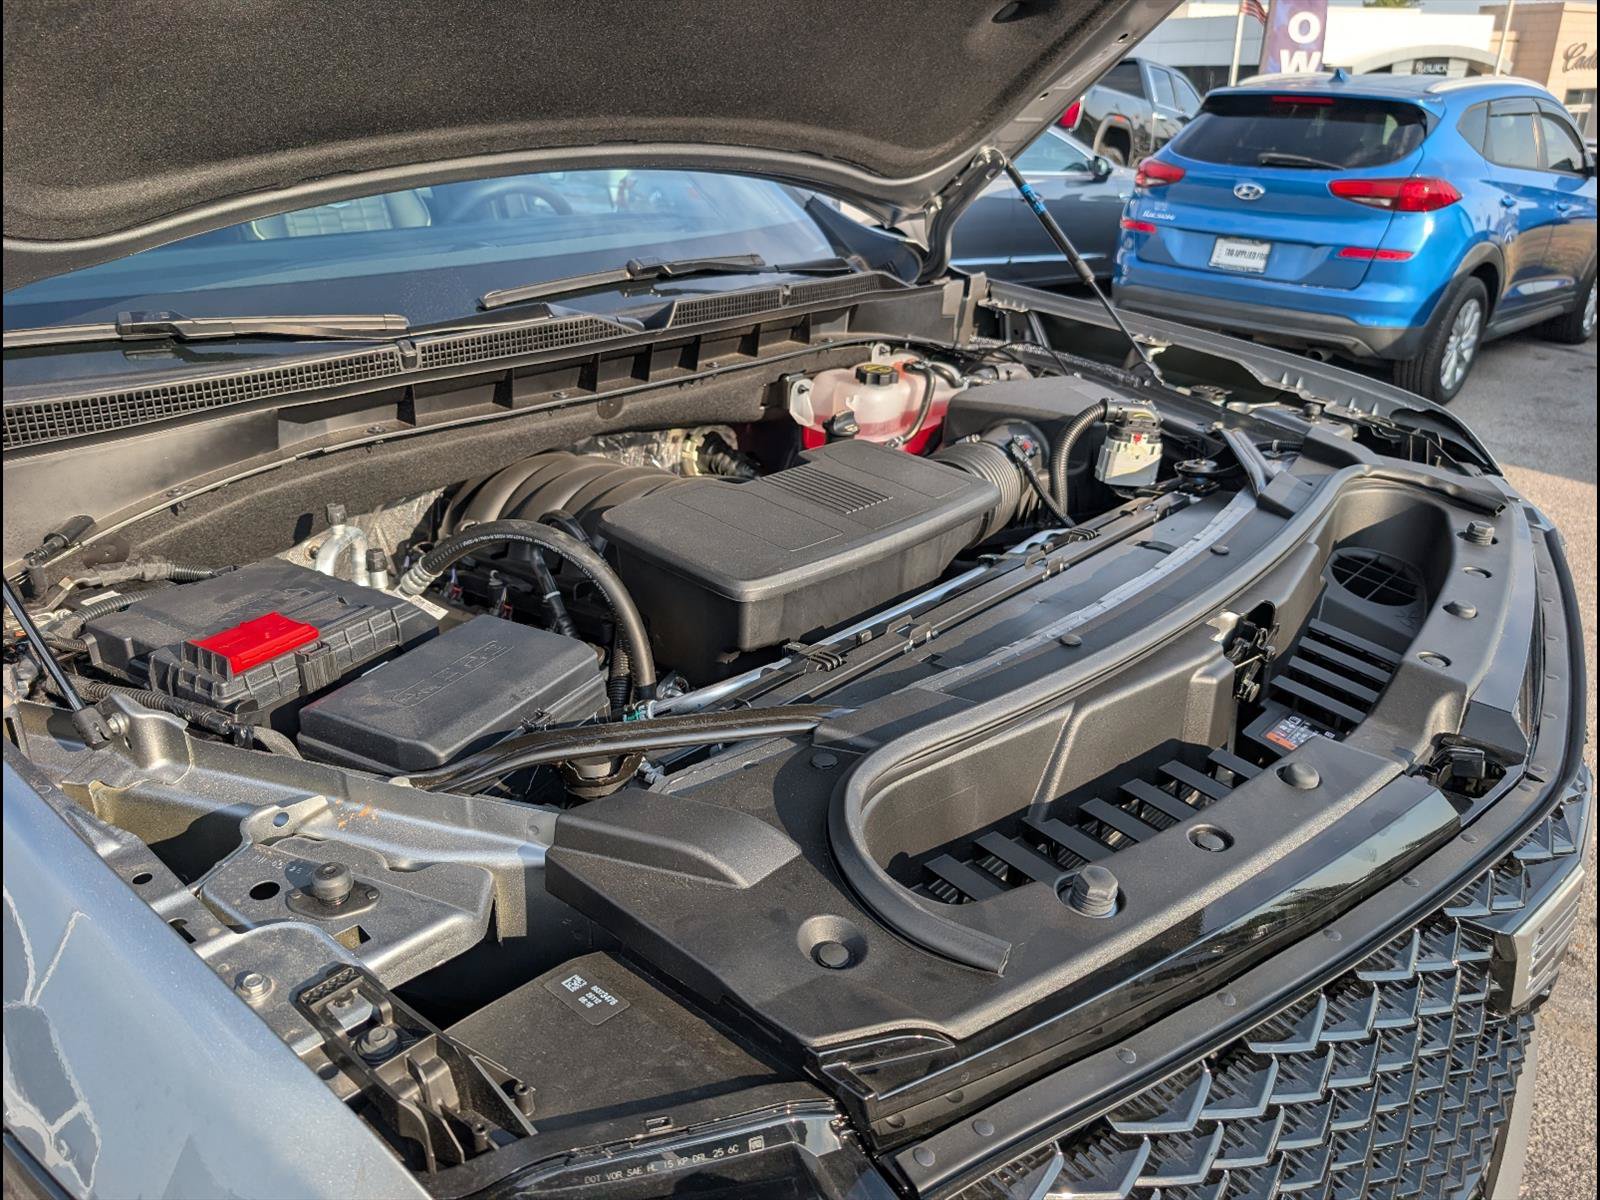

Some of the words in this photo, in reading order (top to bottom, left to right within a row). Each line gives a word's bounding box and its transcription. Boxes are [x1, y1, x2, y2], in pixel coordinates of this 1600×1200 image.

[584, 1174, 600, 1184] DOT
[606, 1170, 623, 1181] VOR
[626, 1166, 643, 1177] SAE
[663, 1160, 674, 1169] 15
